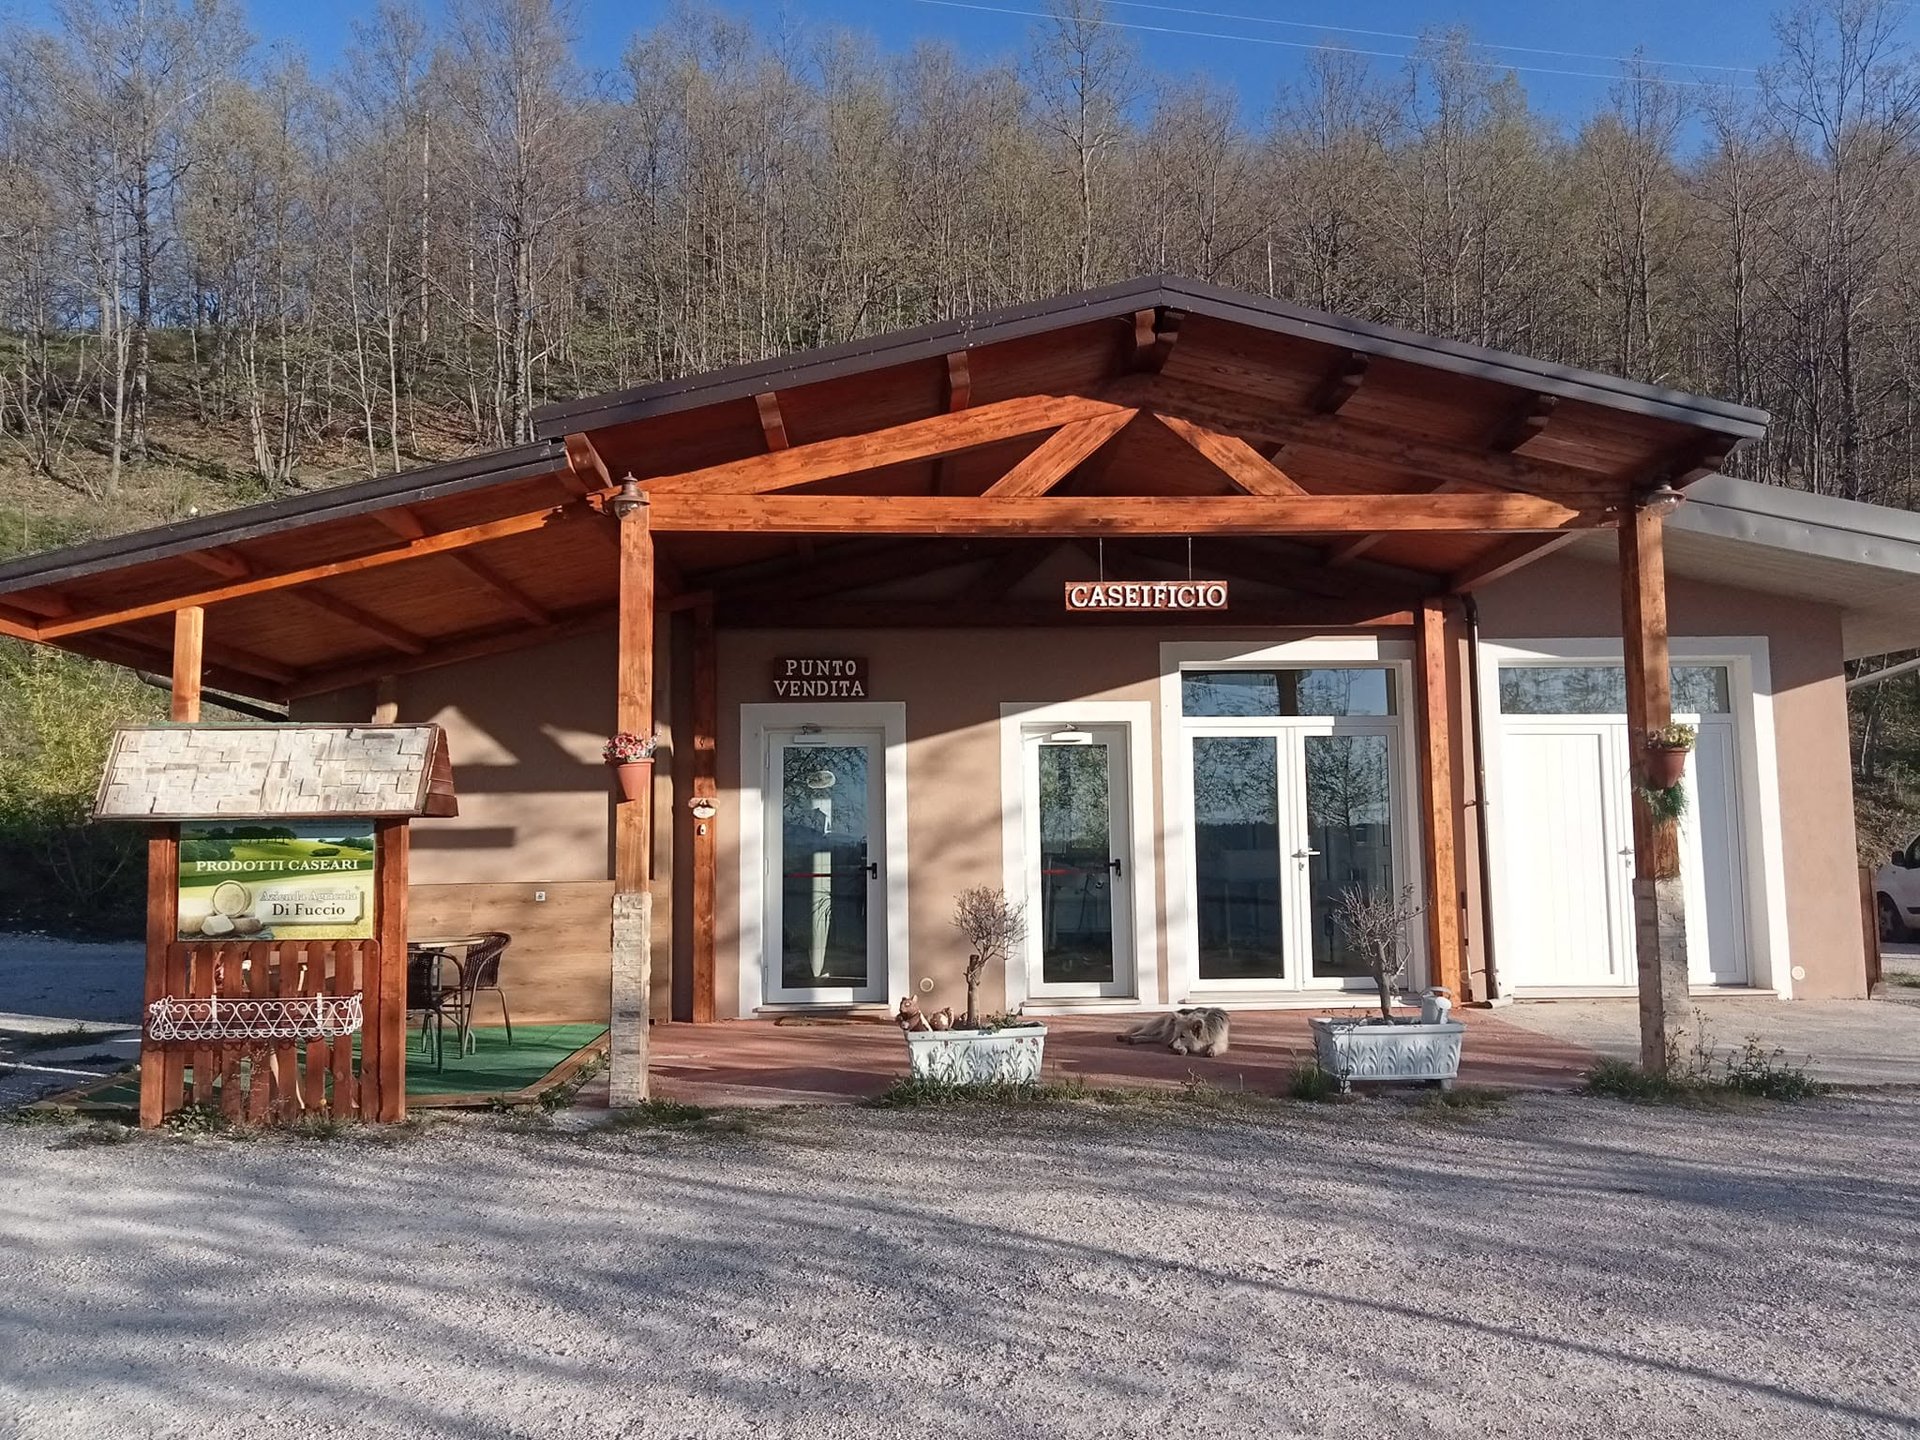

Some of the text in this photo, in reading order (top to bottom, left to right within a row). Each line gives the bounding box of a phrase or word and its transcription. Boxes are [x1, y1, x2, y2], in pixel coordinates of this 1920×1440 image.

[1071, 585, 1227, 608] CASEIFICIO
[785, 659, 857, 676] PUNTO
[773, 680, 865, 697] VENDITA
[196, 859, 359, 872] PRODOTTI CASEARI
[260, 890, 306, 902] Azienda
[272, 902, 346, 916] Di Fuccio
